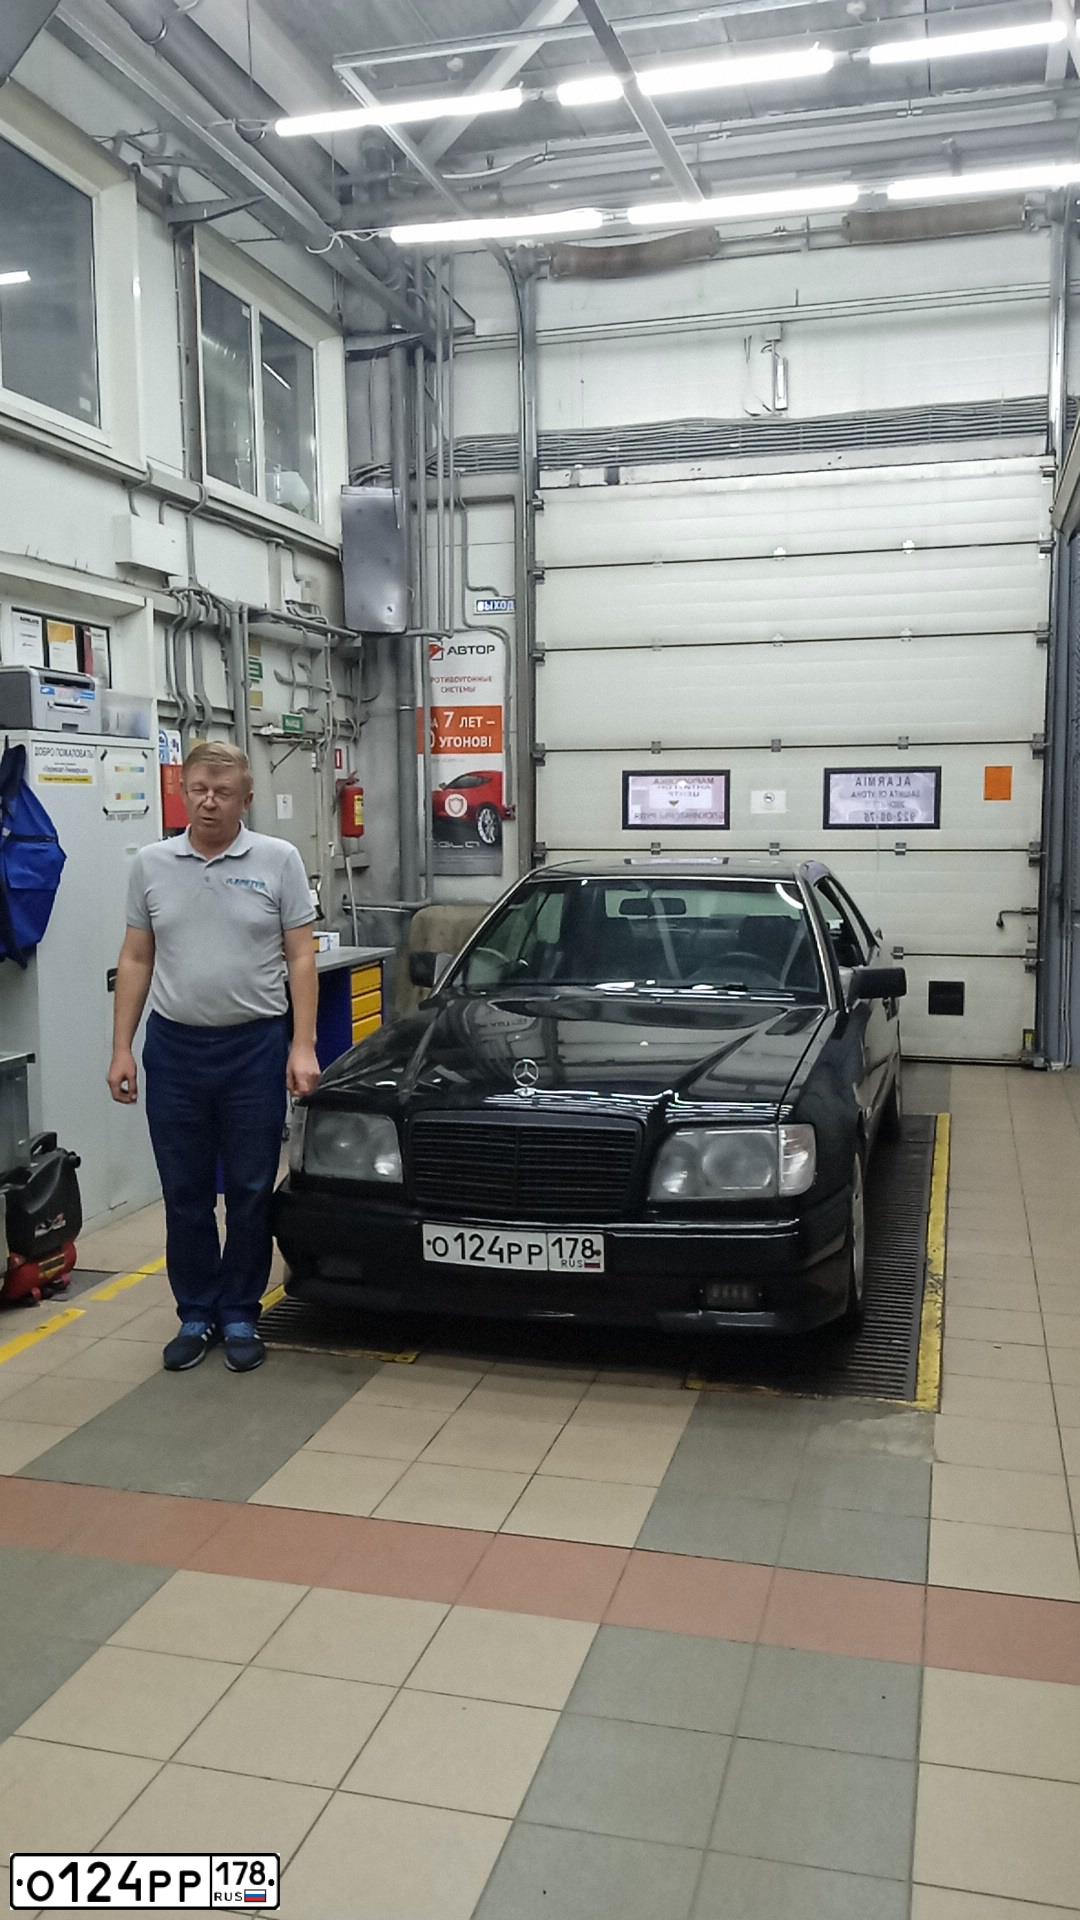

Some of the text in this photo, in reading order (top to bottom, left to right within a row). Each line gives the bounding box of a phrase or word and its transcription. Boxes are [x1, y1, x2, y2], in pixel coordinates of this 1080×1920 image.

[446, 644, 496, 655] АВТОР
[443, 711, 455, 728] 7
[459, 716, 484, 728] ЛЕТ
[439, 735, 492, 748] УГОНОВ!
[551, 1237, 594, 1260] 178
[561, 1260, 583, 1268] RUS
